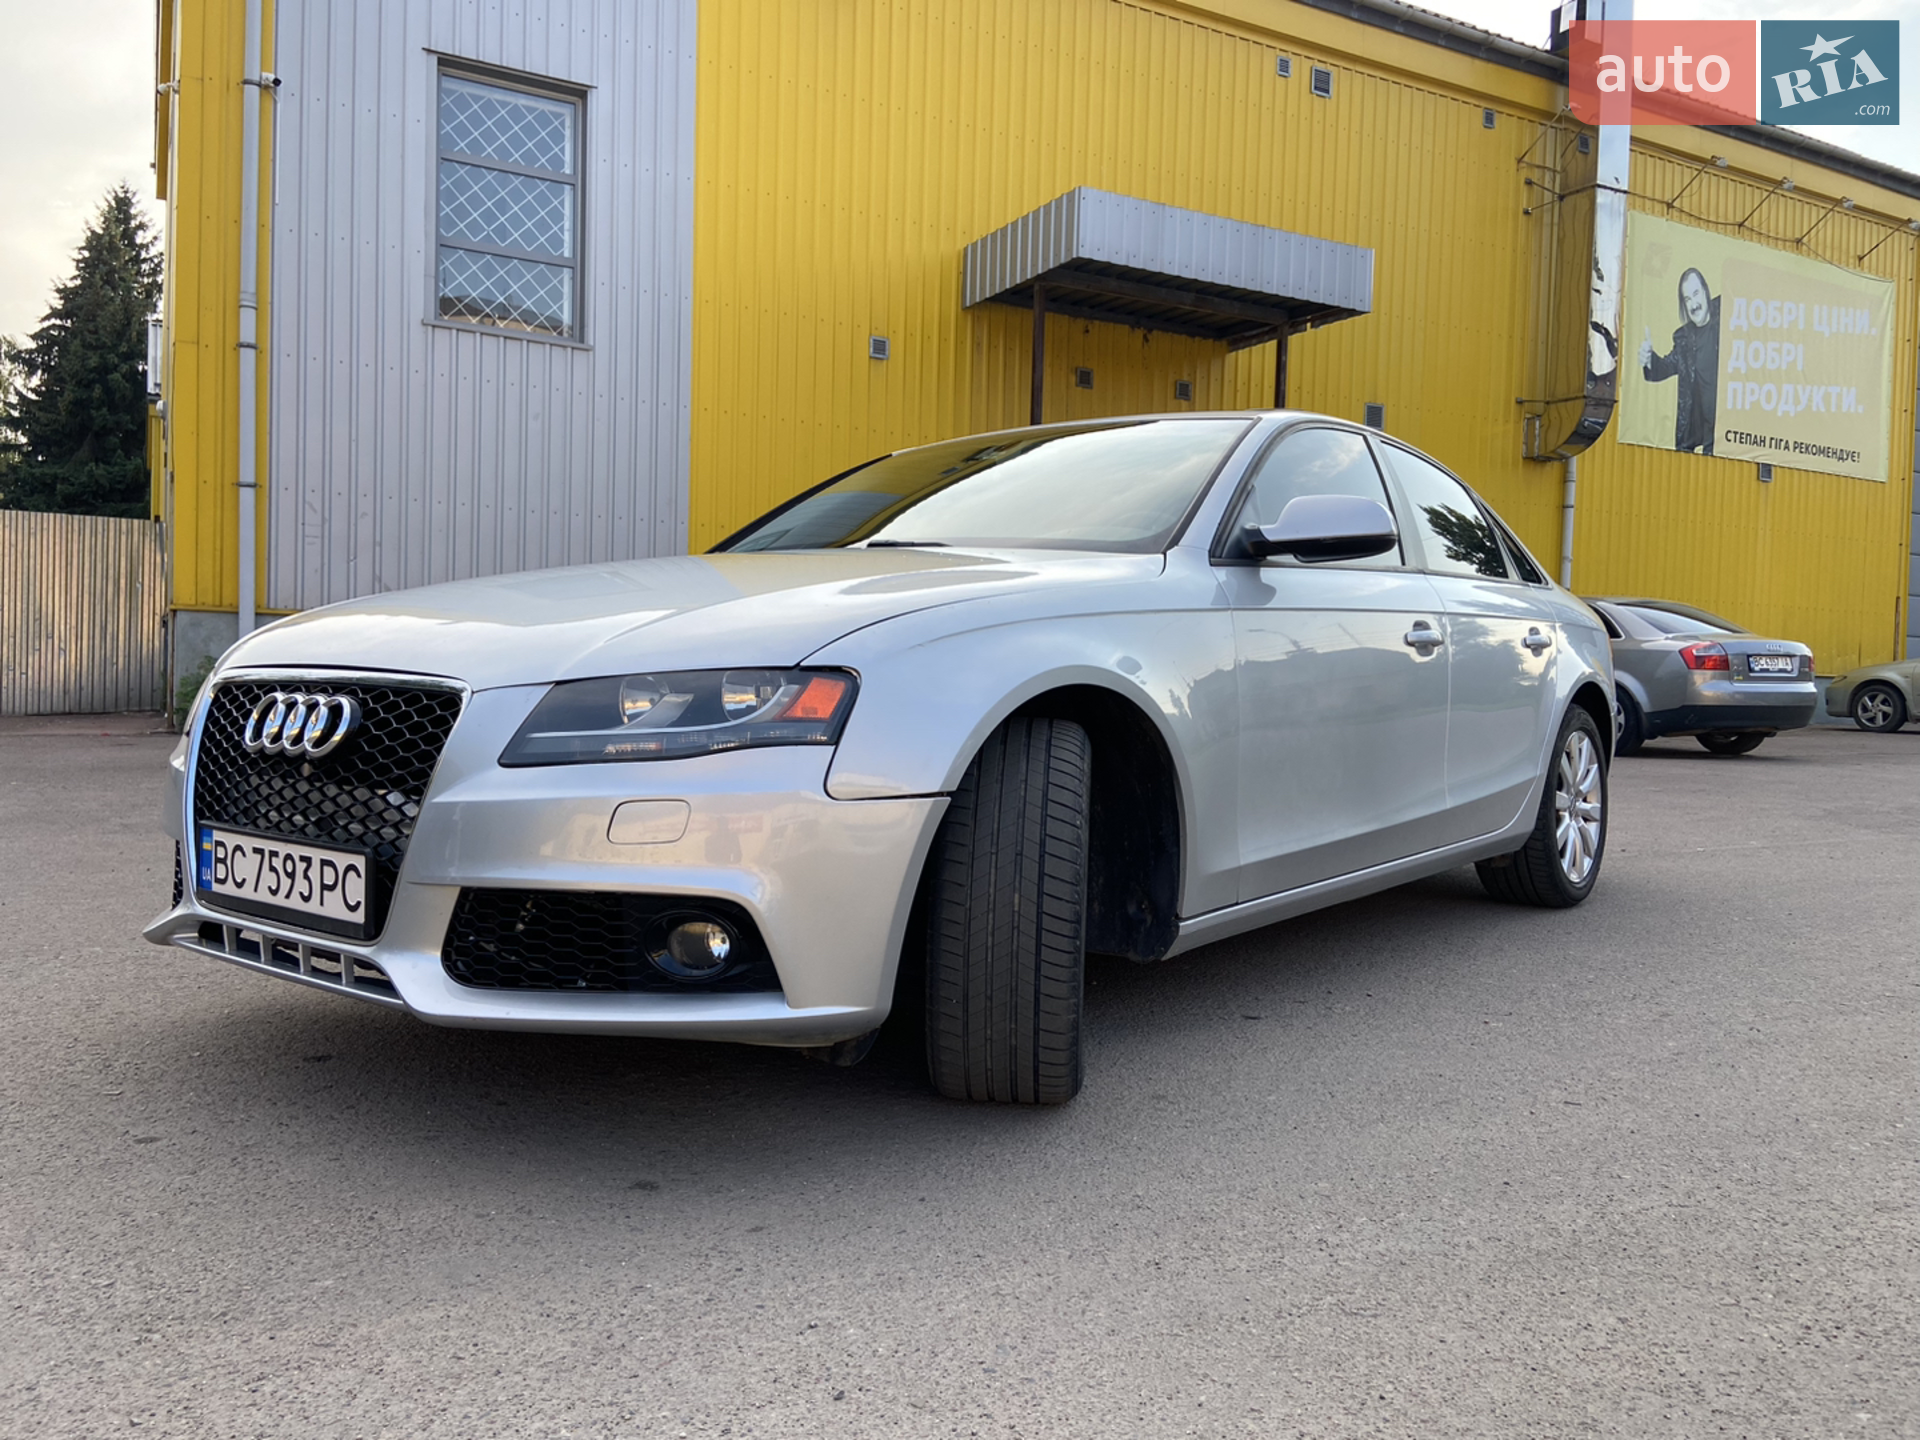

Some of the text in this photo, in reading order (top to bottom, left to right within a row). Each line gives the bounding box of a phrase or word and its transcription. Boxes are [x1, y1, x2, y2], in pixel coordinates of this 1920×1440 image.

[1729, 297, 1878, 337] ДОБРІ ЦІНИ.
[1727, 339, 1804, 374] ДОБРІ
[1726, 381, 1865, 416] ПРОДУКТИ.
[1724, 430, 1861, 463] СТЕПАН ГІГА РЕКОМЕНДУЄ!
[202, 867, 212, 881] UA
